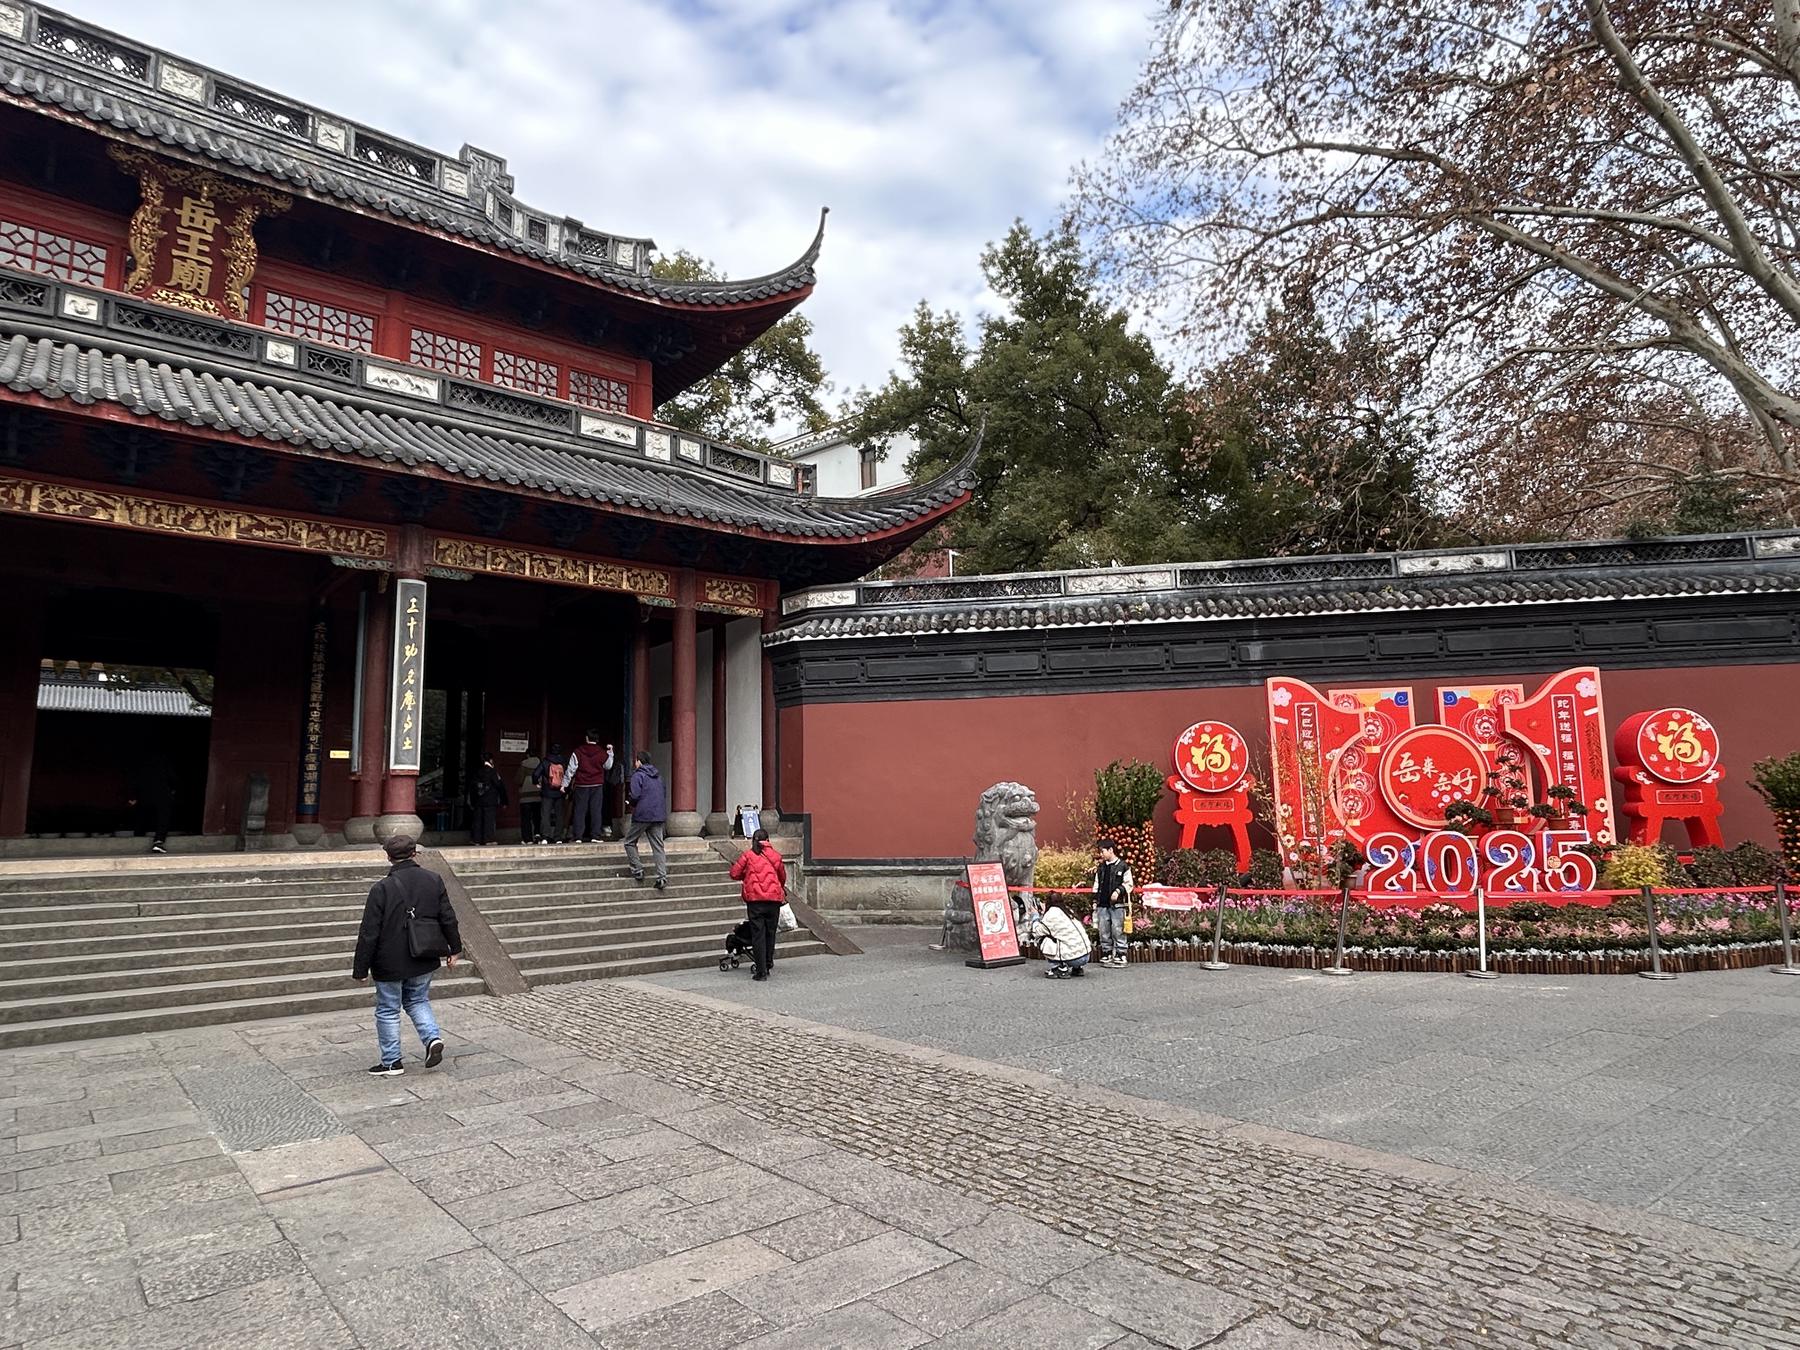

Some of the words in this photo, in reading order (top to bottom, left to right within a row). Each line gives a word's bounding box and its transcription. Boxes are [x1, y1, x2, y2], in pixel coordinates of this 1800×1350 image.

[165, 187, 221, 296] 岳王廟
[1190, 733, 1231, 773] 福
[1657, 720, 1702, 763] 福
[1366, 831, 1597, 899] 2025
